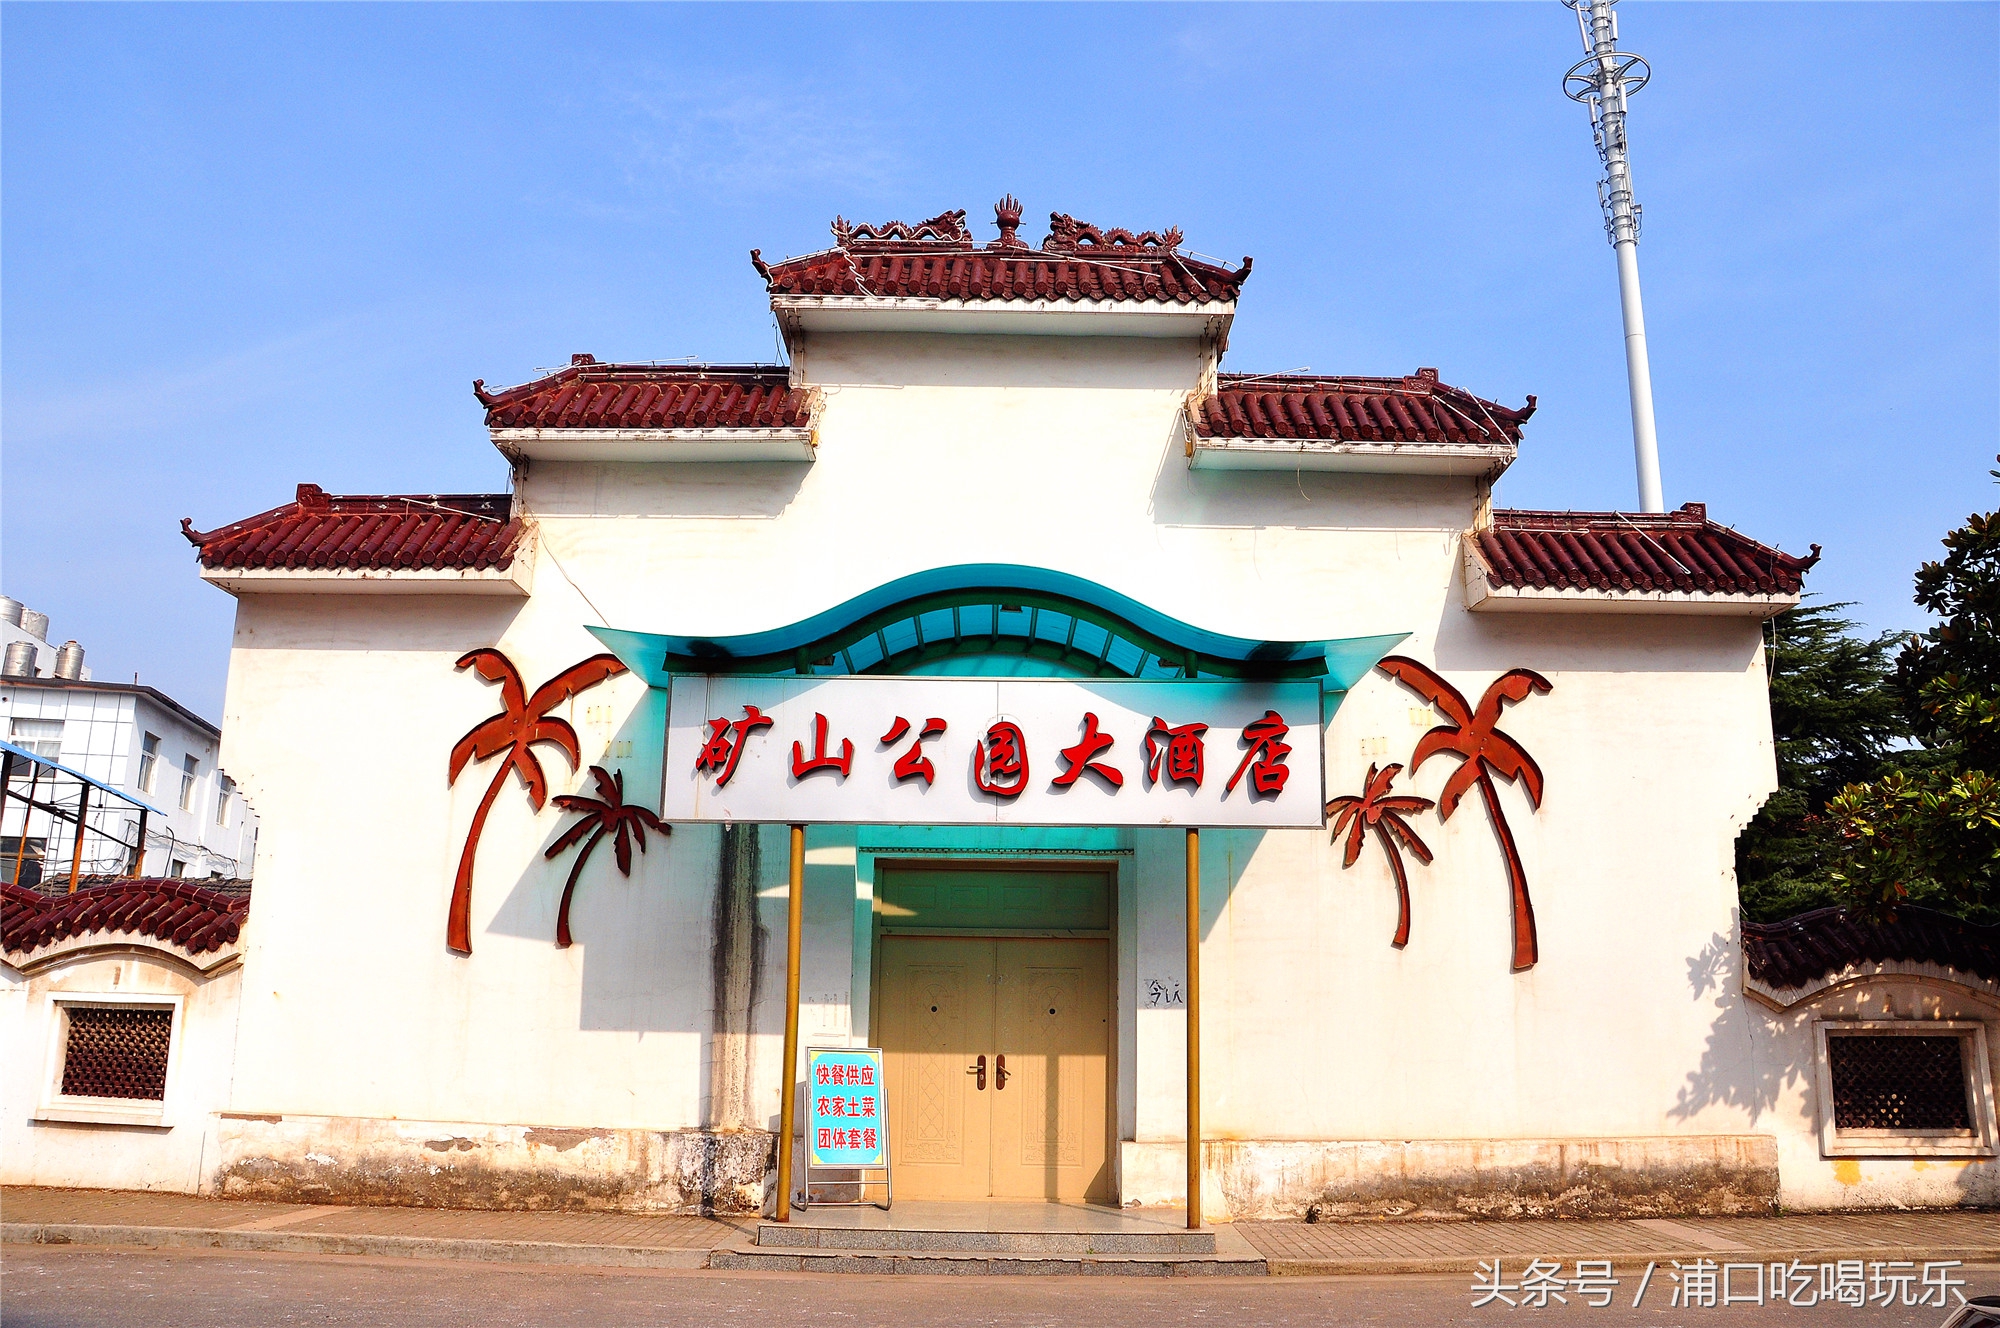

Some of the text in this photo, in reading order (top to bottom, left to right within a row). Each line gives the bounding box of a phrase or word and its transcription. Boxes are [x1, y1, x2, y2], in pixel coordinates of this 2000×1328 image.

[816, 1064, 875, 1086] 快餐供应
[817, 1095, 876, 1118] 农家土菜
[817, 1127, 877, 1149] 团体套餐
